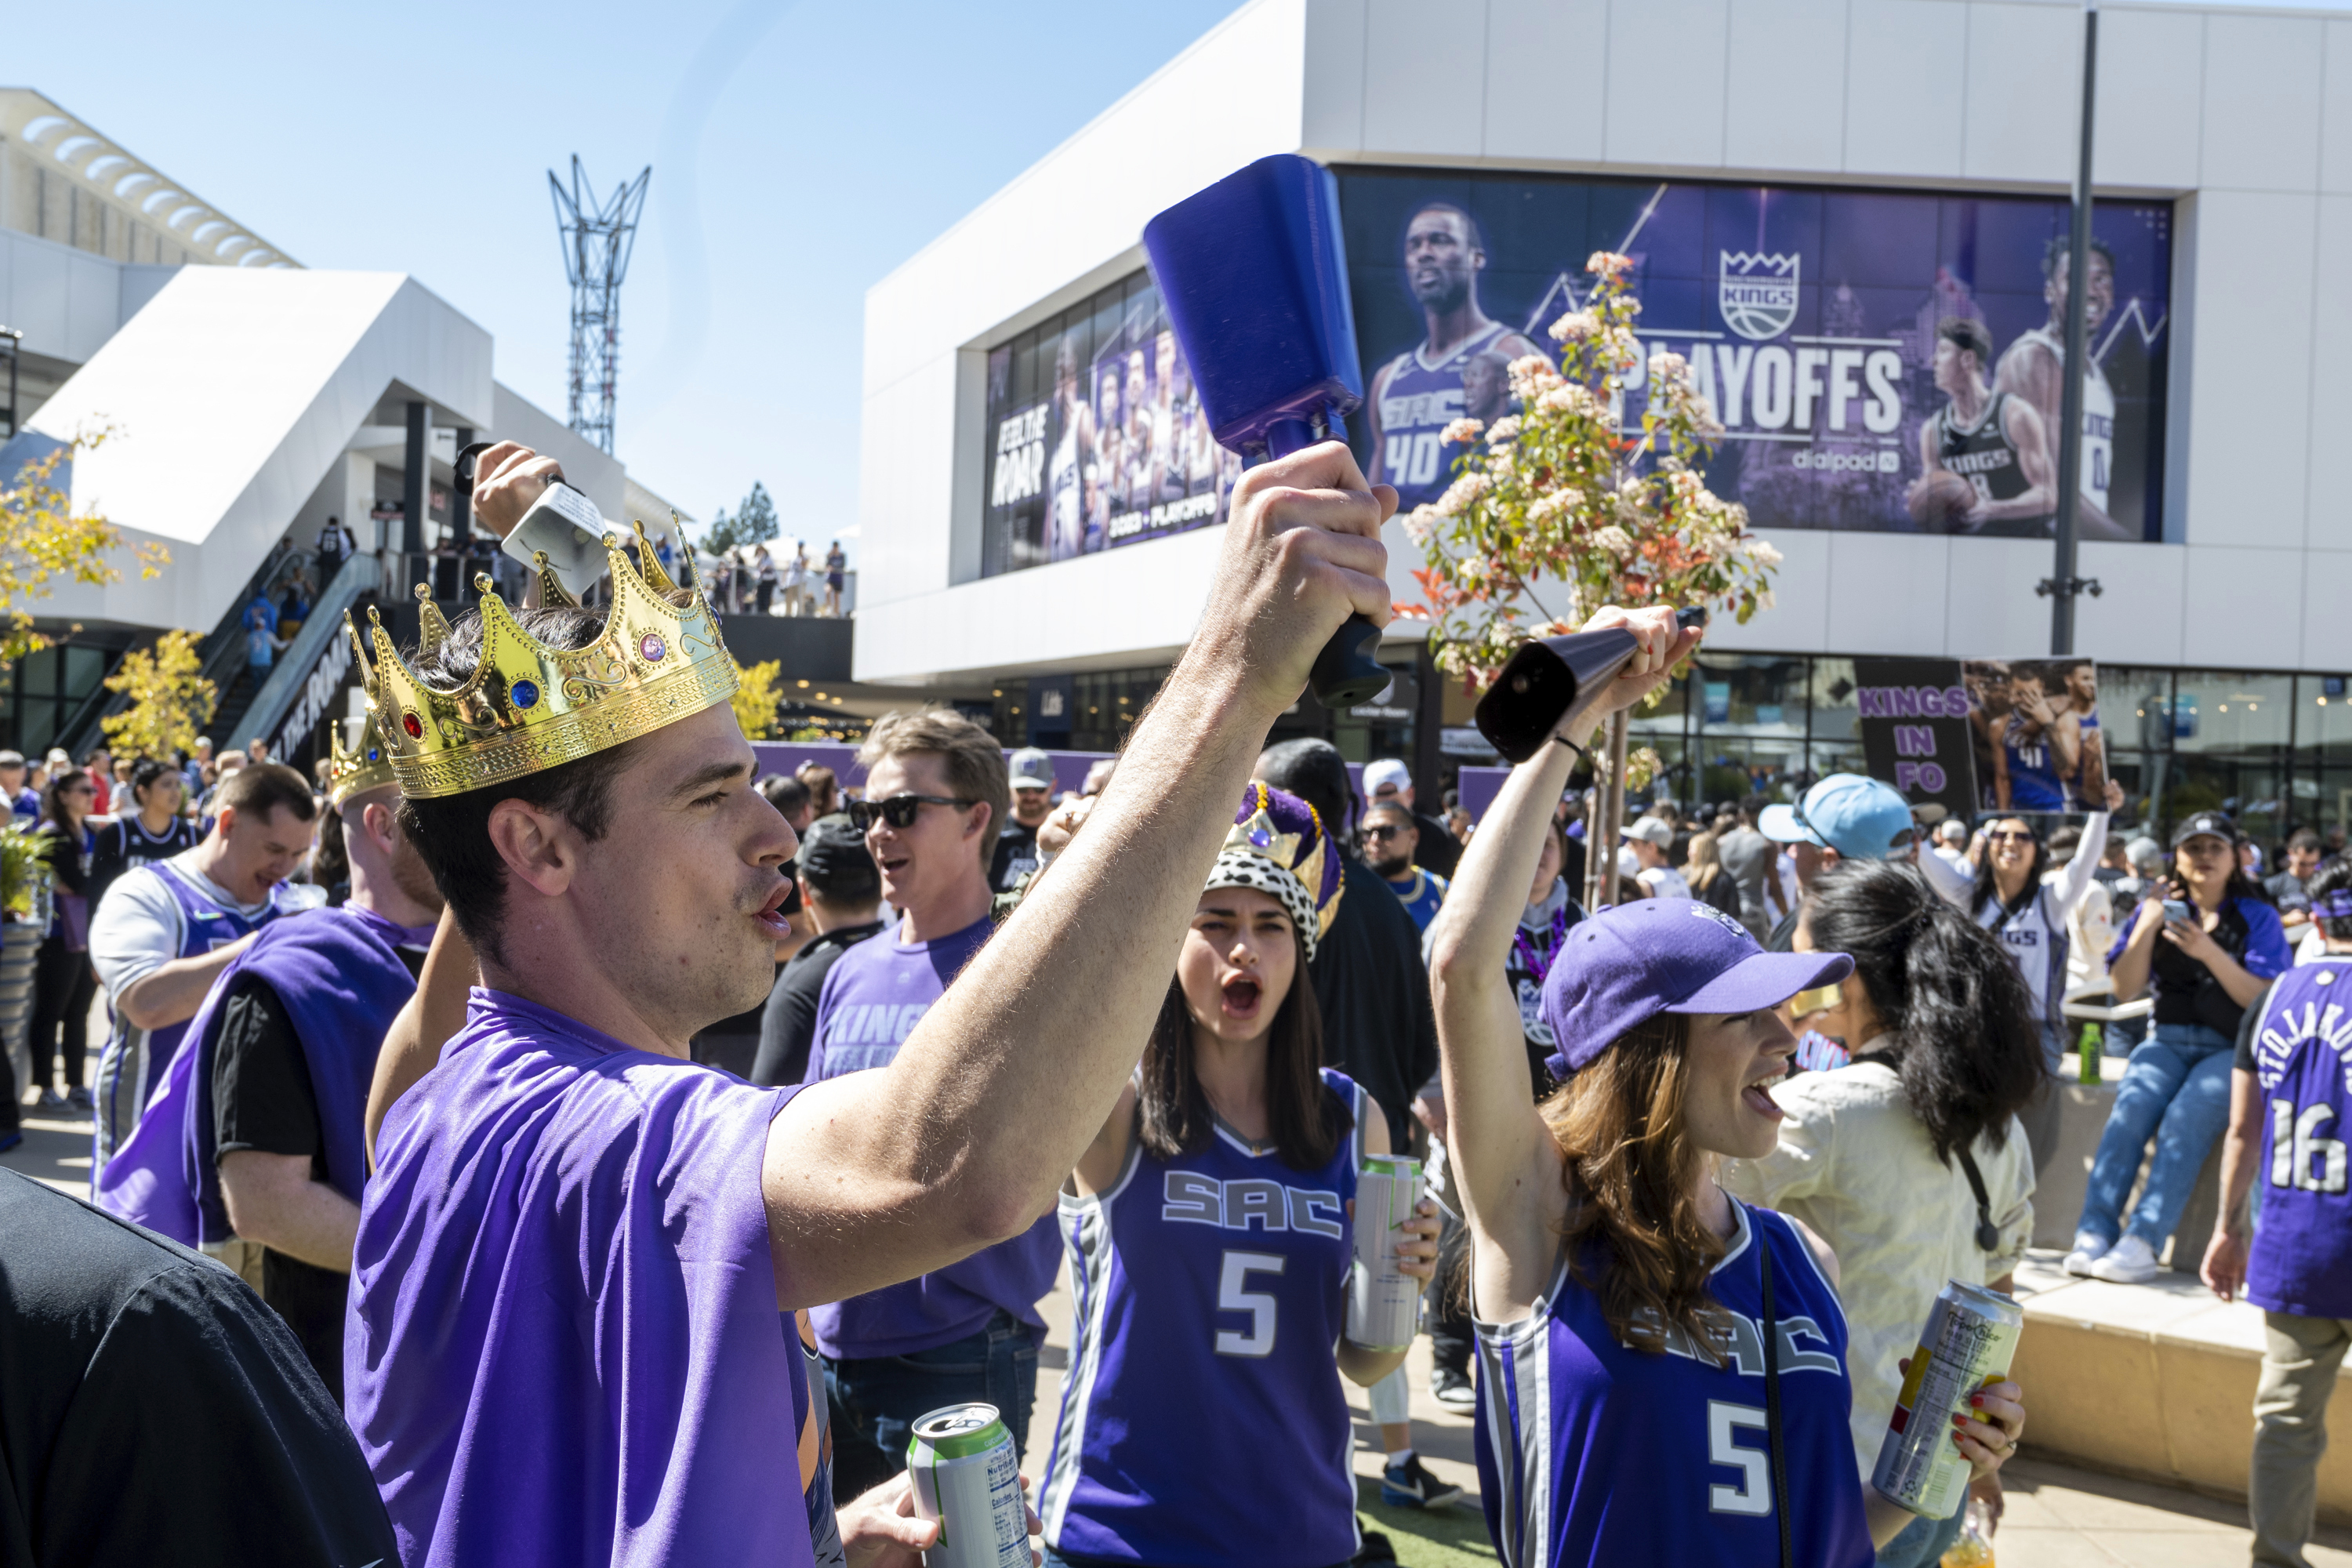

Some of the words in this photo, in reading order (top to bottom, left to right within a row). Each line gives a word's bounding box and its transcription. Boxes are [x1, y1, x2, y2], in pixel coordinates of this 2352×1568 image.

[1724, 288, 1793, 305] KINGS
[1381, 387, 1467, 430] SAC
[1385, 432, 1440, 485] 40
[1792, 449, 1876, 475] dialpad
[1108, 510, 1143, 539] 2023
[1149, 491, 1218, 528] PLAYOFFS
[1857, 685, 1969, 719] KINGS
[1893, 724, 1937, 757] IN
[2018, 746, 2043, 768] 41
[1894, 760, 1947, 793] FO
[829, 1003, 931, 1045] KING
[2270, 1098, 2347, 1192] 16
[1161, 1170, 1342, 1240] SAC
[1215, 1249, 1287, 1359] 5
[1707, 1398, 1773, 1518] 5
[992, 1493, 1012, 1507] Calories
